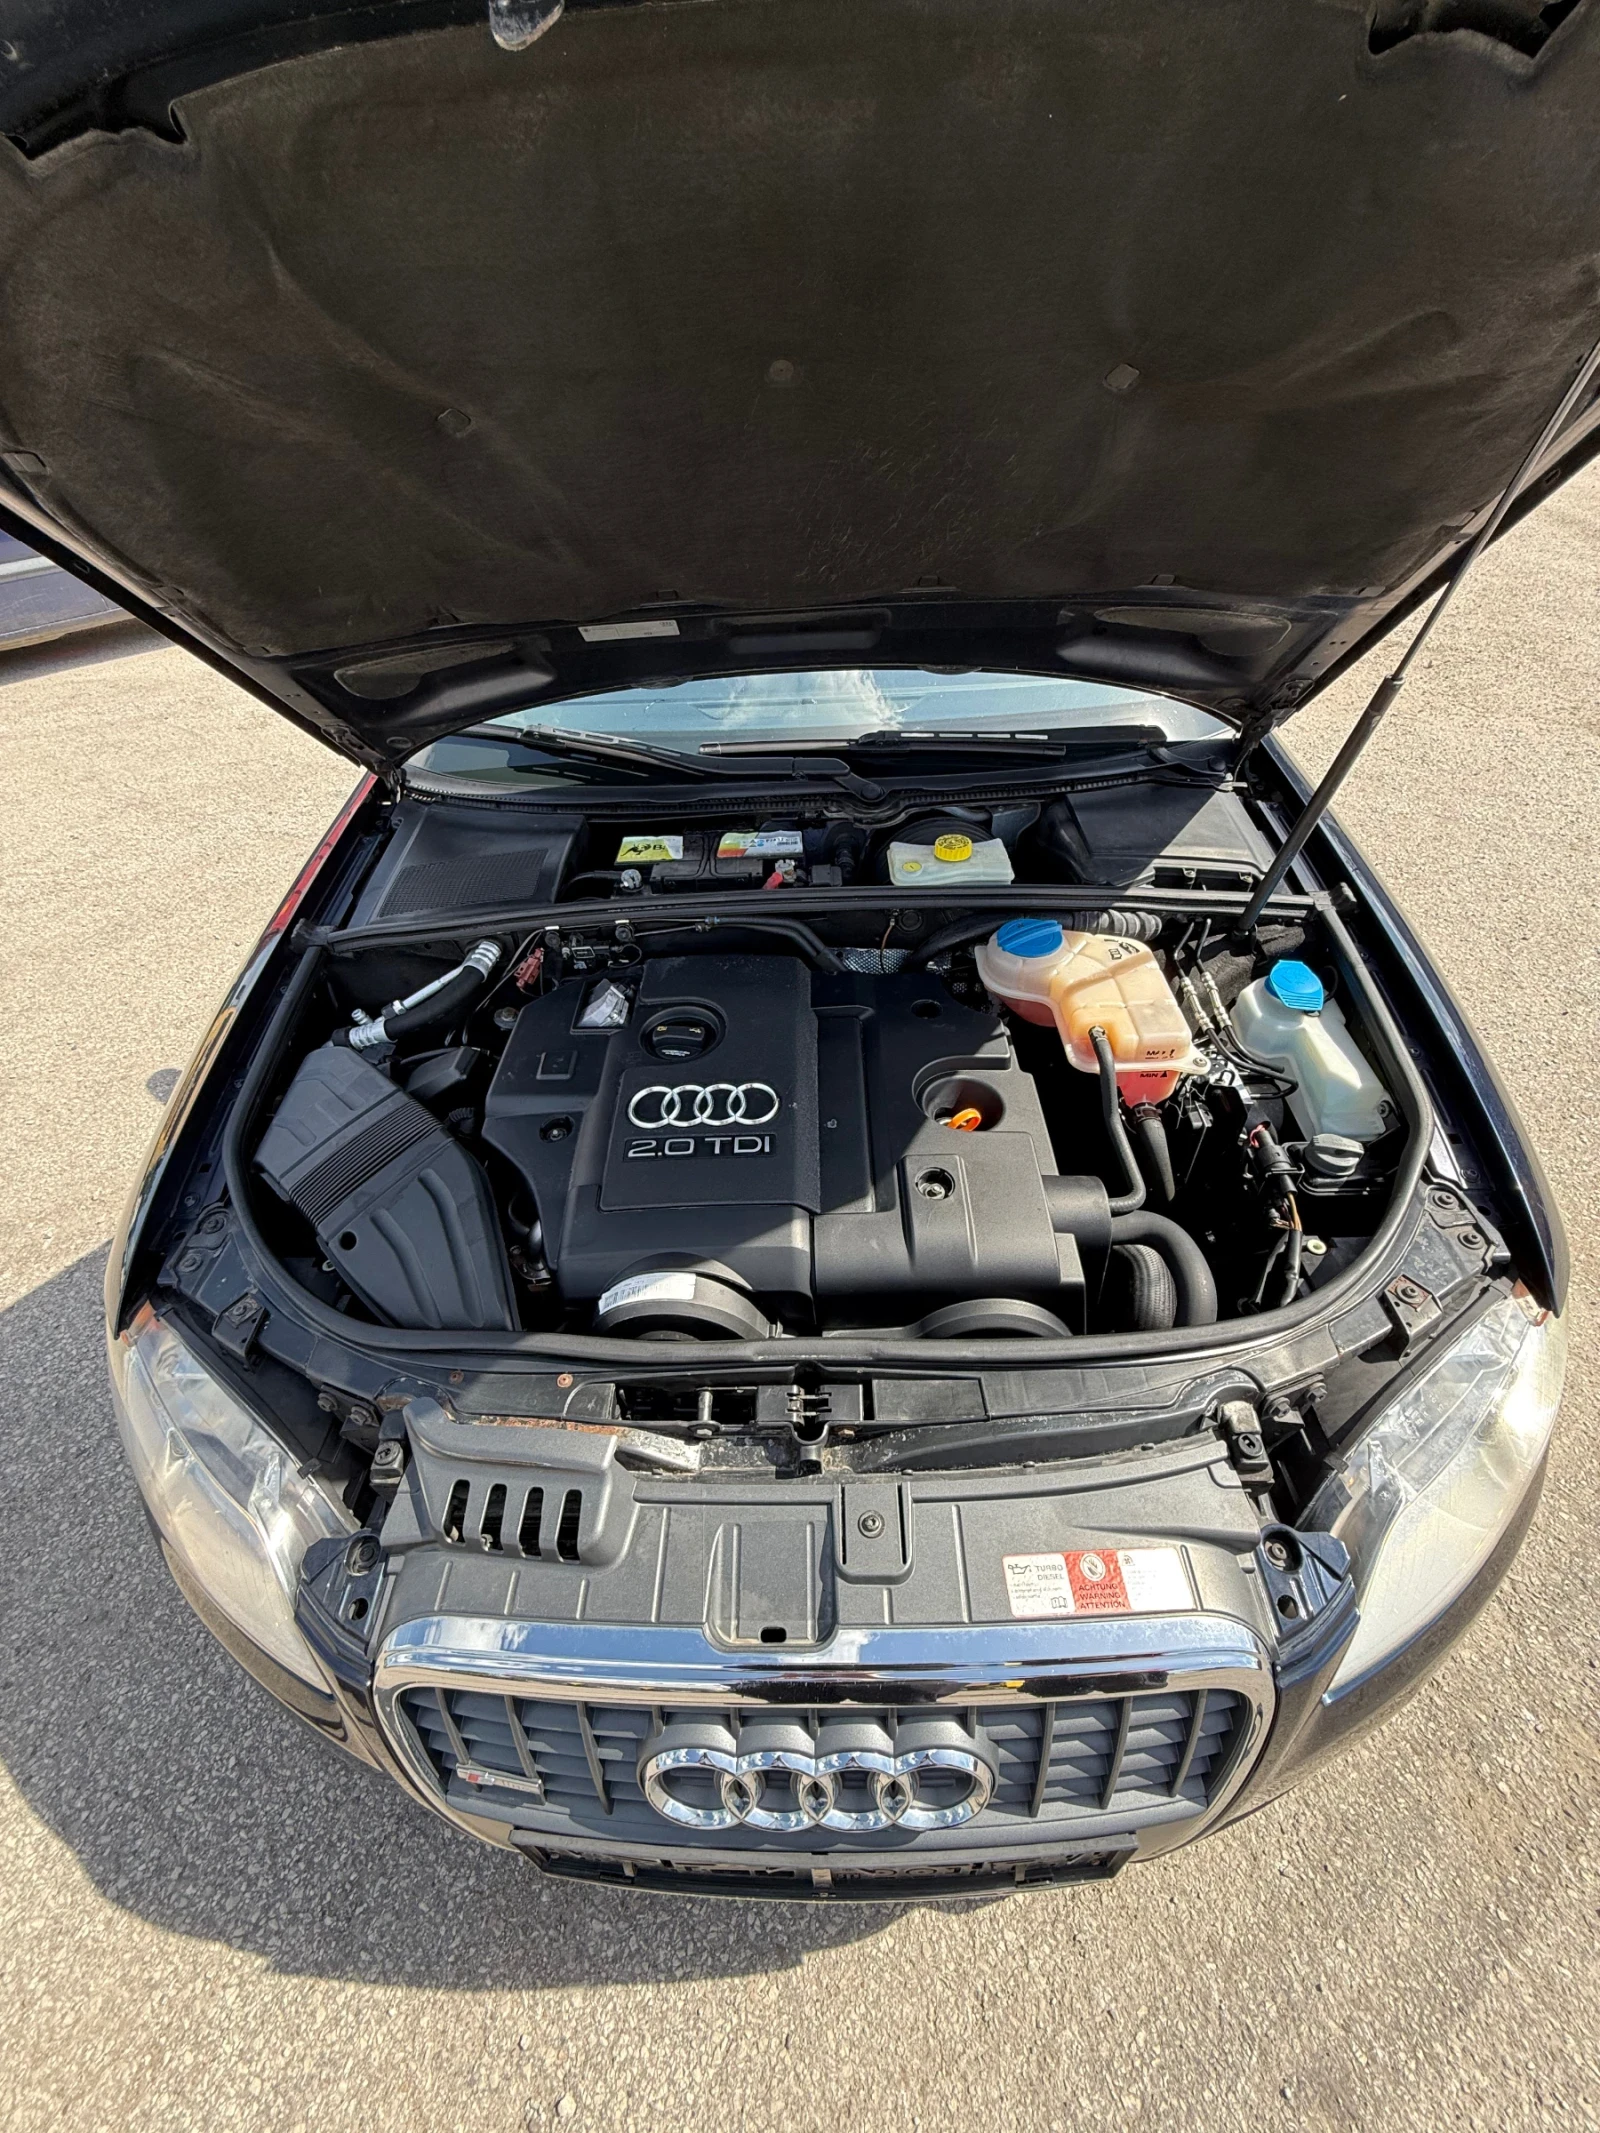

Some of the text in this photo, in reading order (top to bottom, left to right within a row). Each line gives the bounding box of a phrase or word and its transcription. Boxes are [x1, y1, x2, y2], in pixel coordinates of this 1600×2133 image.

[627, 1136, 770, 1157] 2.0 TDI
[1034, 1564, 1064, 1572] TURBO
[1037, 1573, 1064, 1581] DIESEL
[1078, 1582, 1118, 1591] ACHTUNG
[1080, 1591, 1121, 1601] WARNING
[1080, 1600, 1126, 1609] ATTENTION
